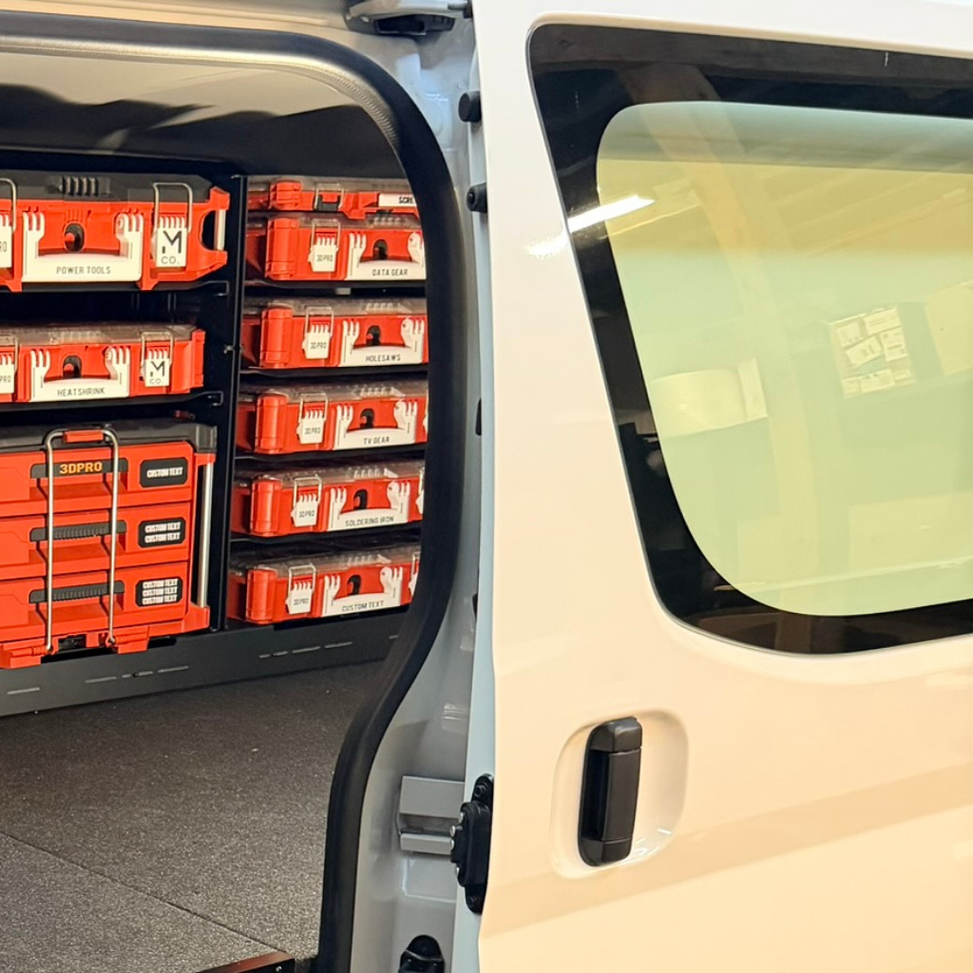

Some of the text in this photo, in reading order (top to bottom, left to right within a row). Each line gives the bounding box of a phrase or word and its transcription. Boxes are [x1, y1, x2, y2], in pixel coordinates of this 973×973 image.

[56, 266, 111, 275] POWER TOOLS
[391, 268, 408, 276] GEAR
[365, 354, 401, 362] HOLESAWS
[57, 388, 105, 397] HEATSHRINK
[363, 436, 390, 445] TV GEAR
[59, 461, 103, 475] 3DPRO
[345, 515, 394, 527] SOLDERING IRON
[341, 600, 384, 612] CUSTOM TEXT
